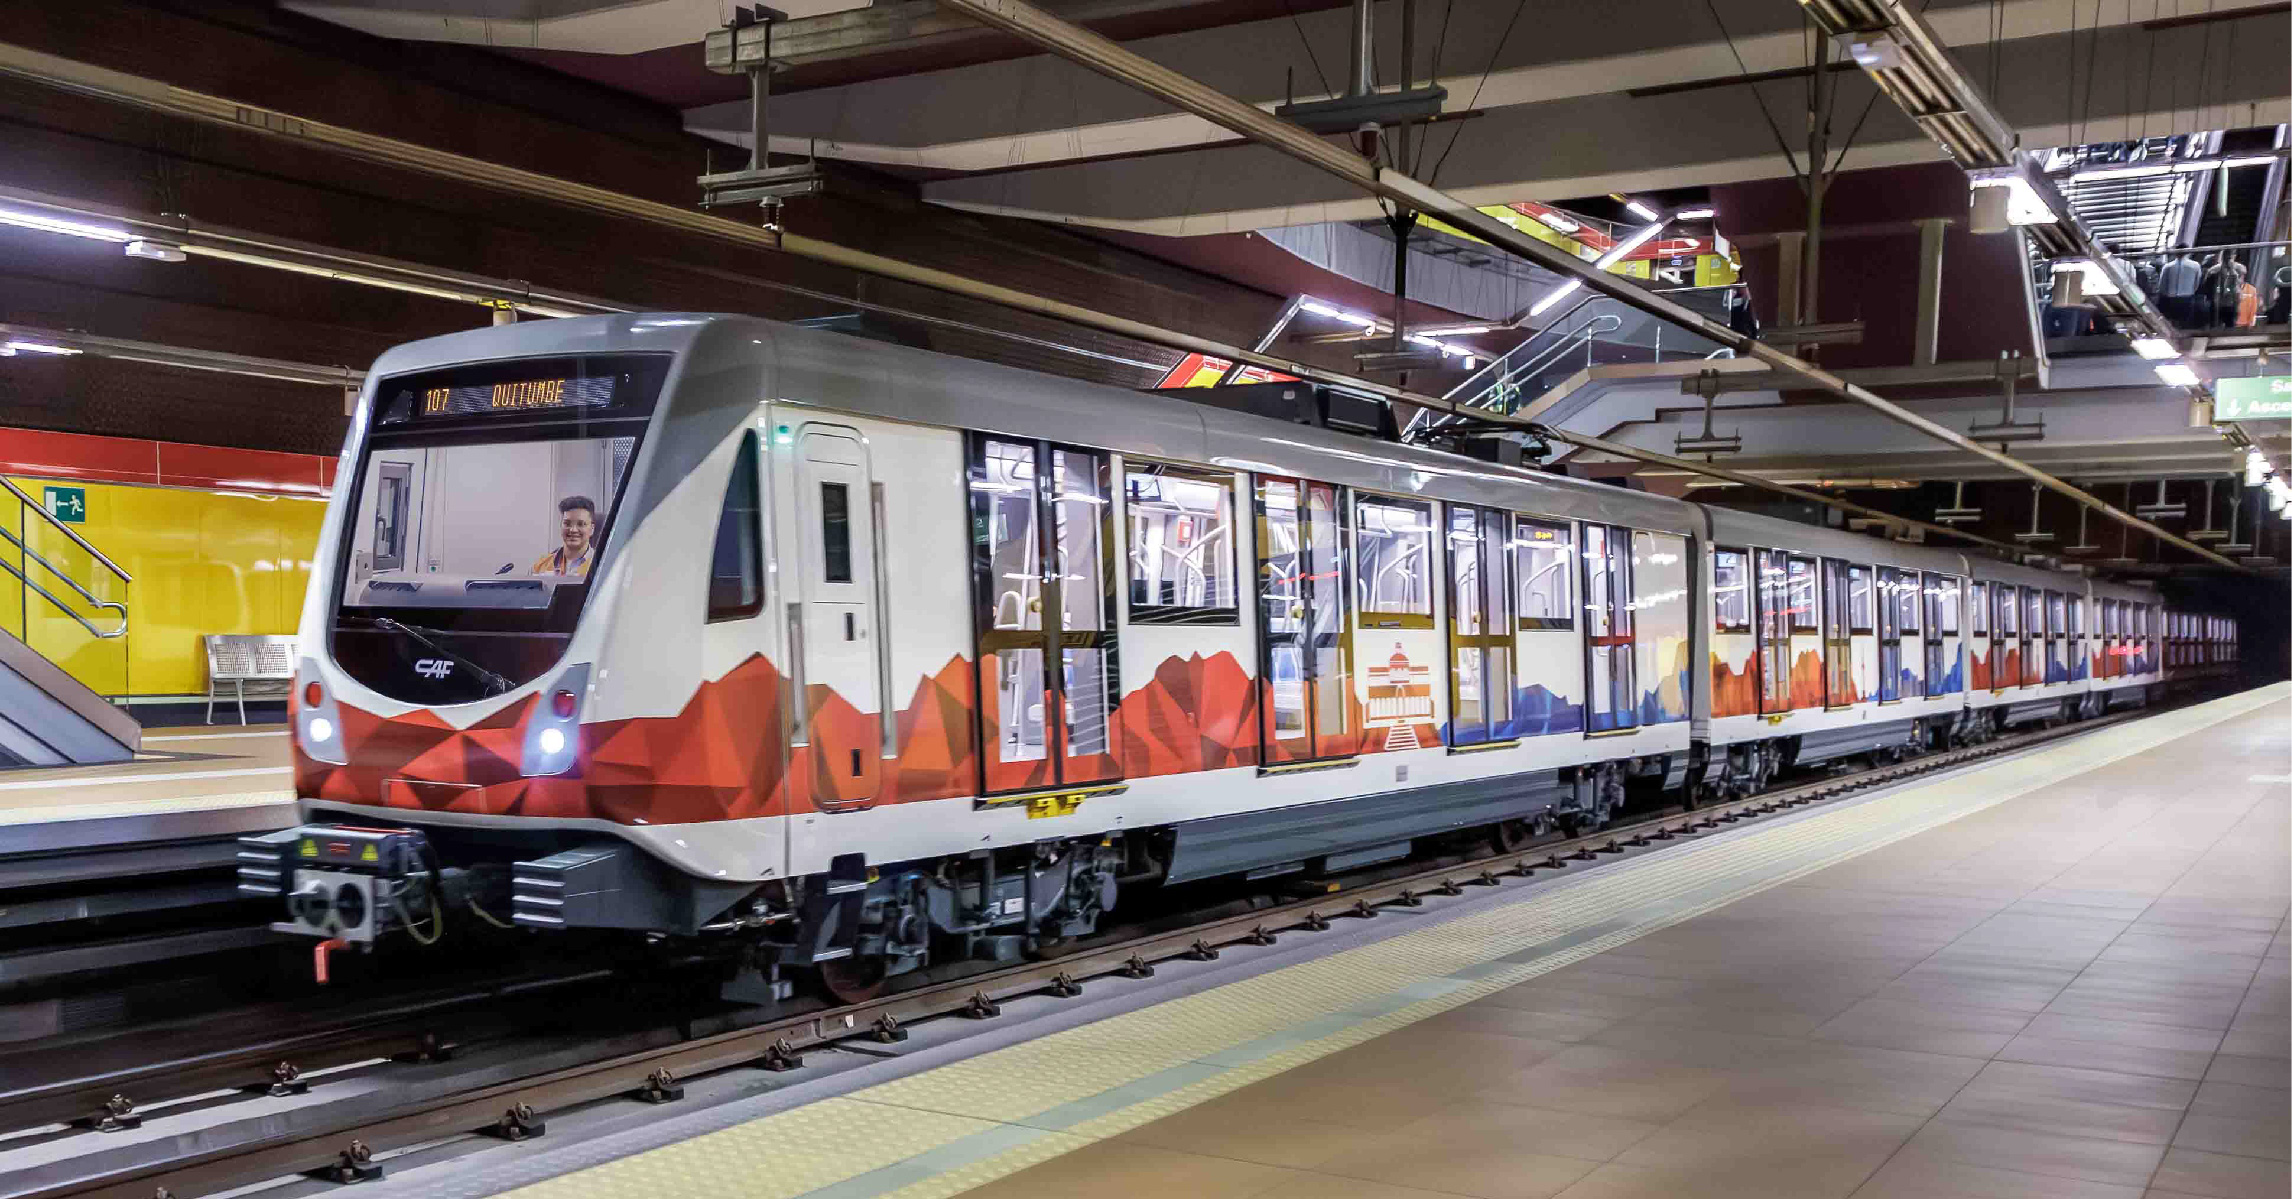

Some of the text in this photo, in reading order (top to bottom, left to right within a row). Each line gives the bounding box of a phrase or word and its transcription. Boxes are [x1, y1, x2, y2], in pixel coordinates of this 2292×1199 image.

[426, 380, 565, 411] 107 QUITUMBE
[415, 659, 454, 678] CAF
